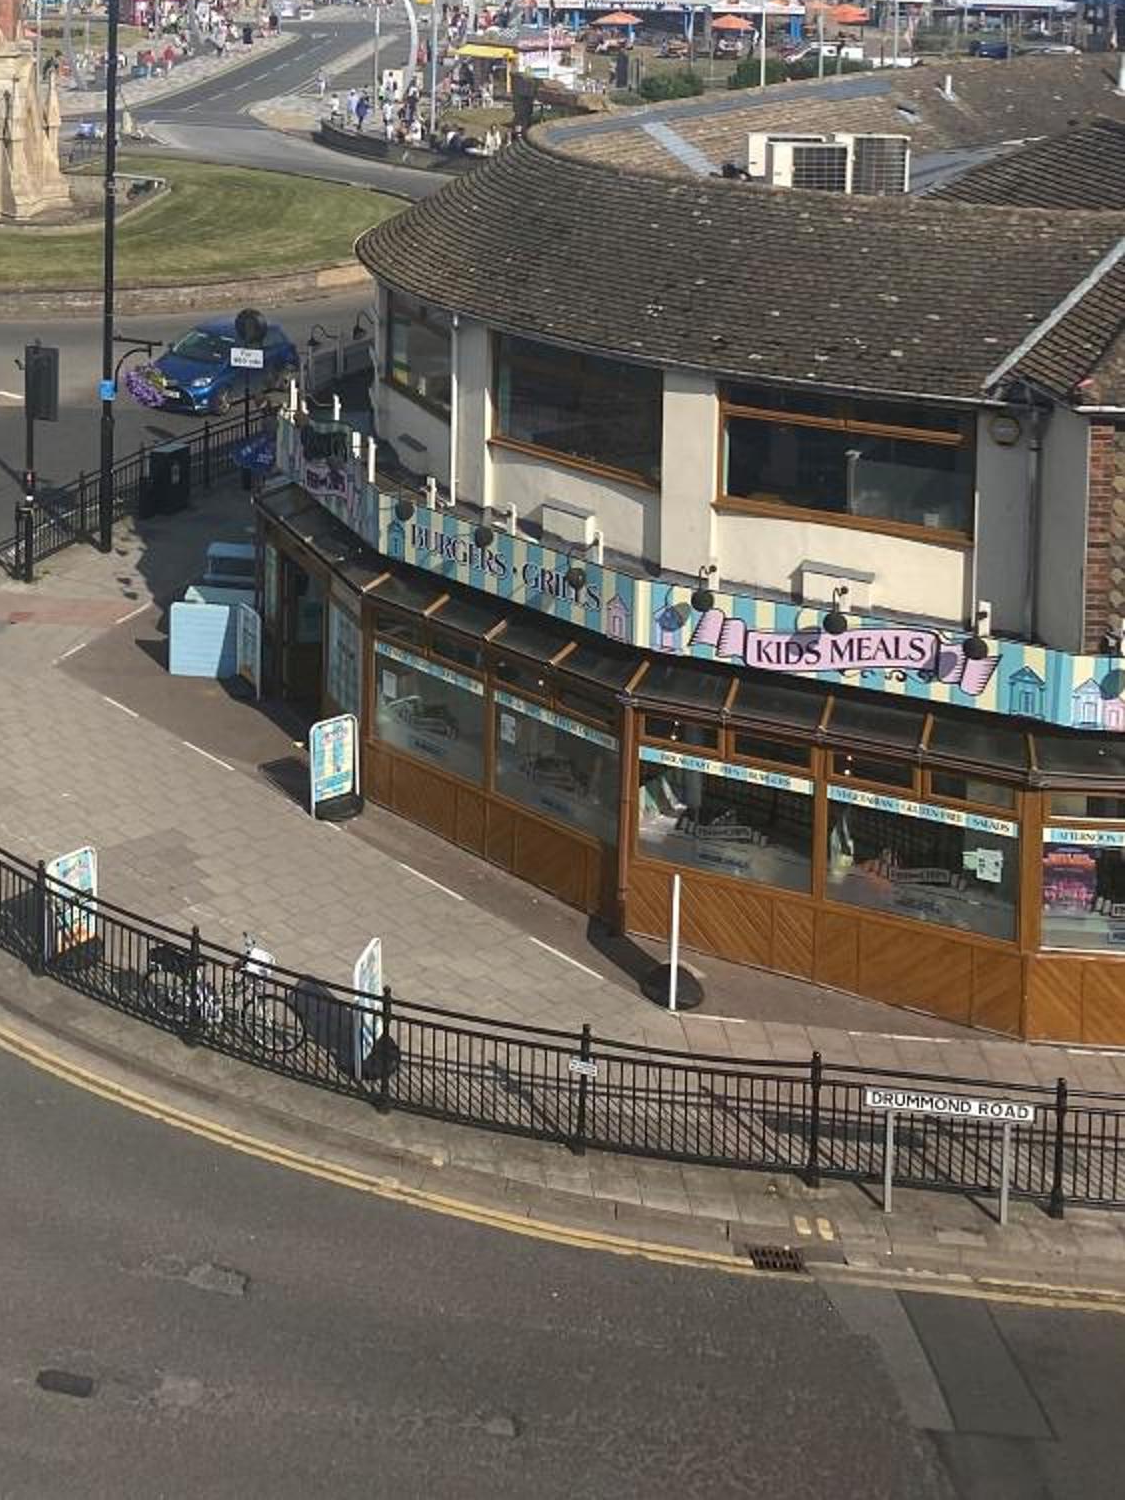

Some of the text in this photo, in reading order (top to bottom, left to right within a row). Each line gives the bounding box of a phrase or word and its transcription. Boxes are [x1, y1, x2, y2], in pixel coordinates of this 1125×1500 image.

[411, 524, 601, 611] BURGERS GRILLS
[756, 635, 926, 665] KIDS MEALS
[872, 1091, 1029, 1120] DRUMMOND ROAD
